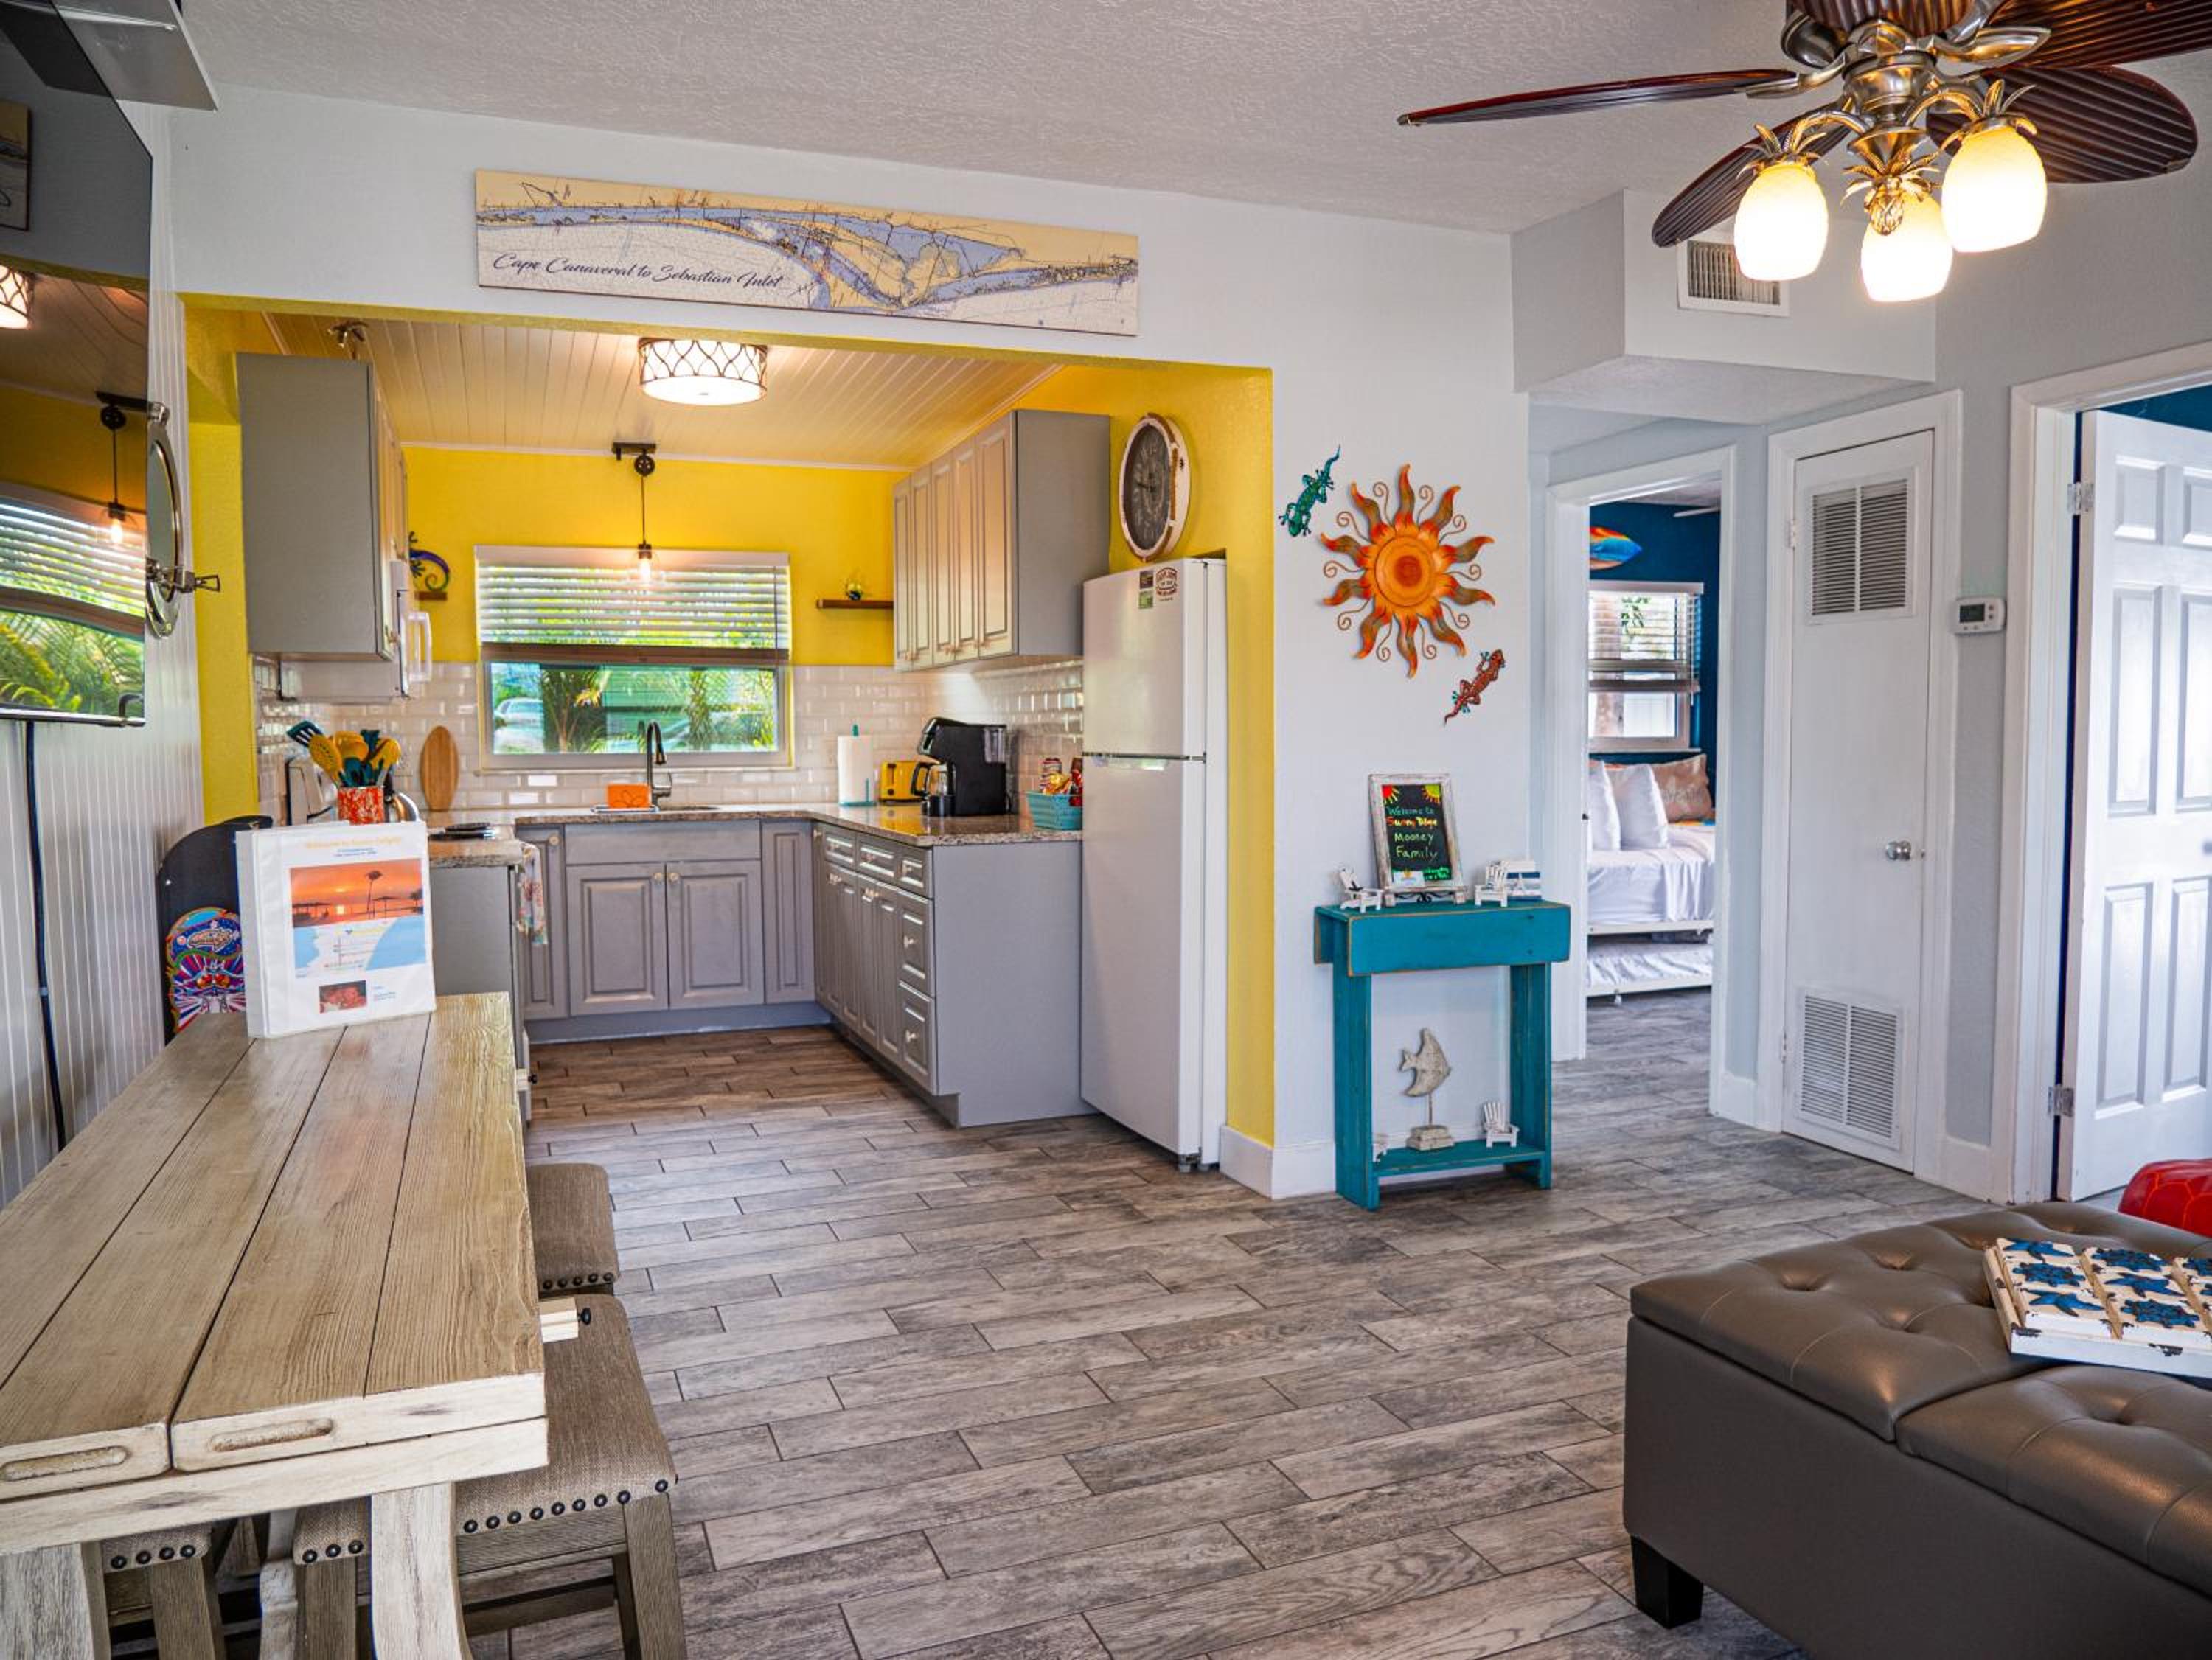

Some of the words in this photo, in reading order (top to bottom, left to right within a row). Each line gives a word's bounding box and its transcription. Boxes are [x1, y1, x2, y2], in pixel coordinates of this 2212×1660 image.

[493, 252, 541, 275] Cape
[546, 258, 638, 277] Canaveral
[637, 264, 652, 277] to
[652, 265, 732, 283] Sebastian
[737, 271, 784, 288] Inlet
[1394, 832, 1433, 845] Mooney
[1396, 845, 1437, 862] Family
